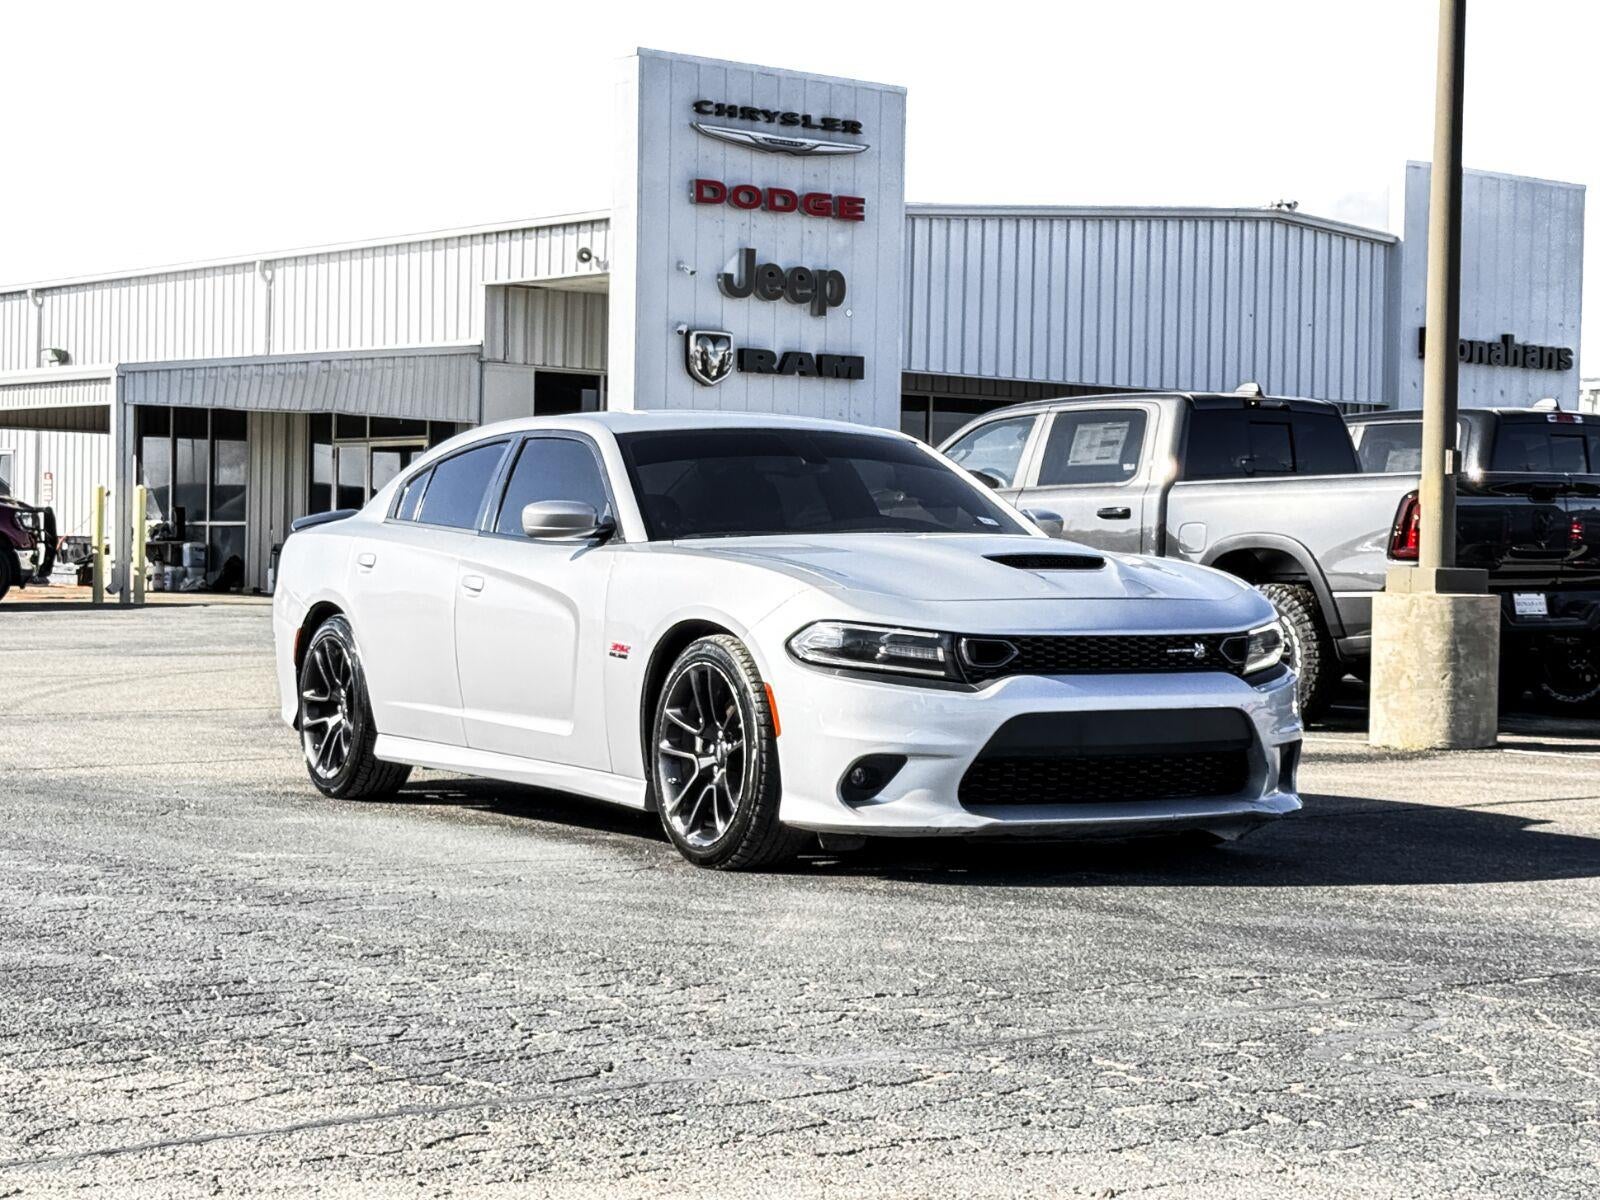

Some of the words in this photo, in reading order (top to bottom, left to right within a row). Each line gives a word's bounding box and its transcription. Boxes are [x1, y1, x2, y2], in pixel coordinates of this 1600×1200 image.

[692, 99, 863, 134] CHRYSLER
[690, 178, 866, 221] DODGE
[717, 248, 846, 317] Jeep
[737, 347, 865, 380] RAM
[1418, 327, 1573, 371] onahans
